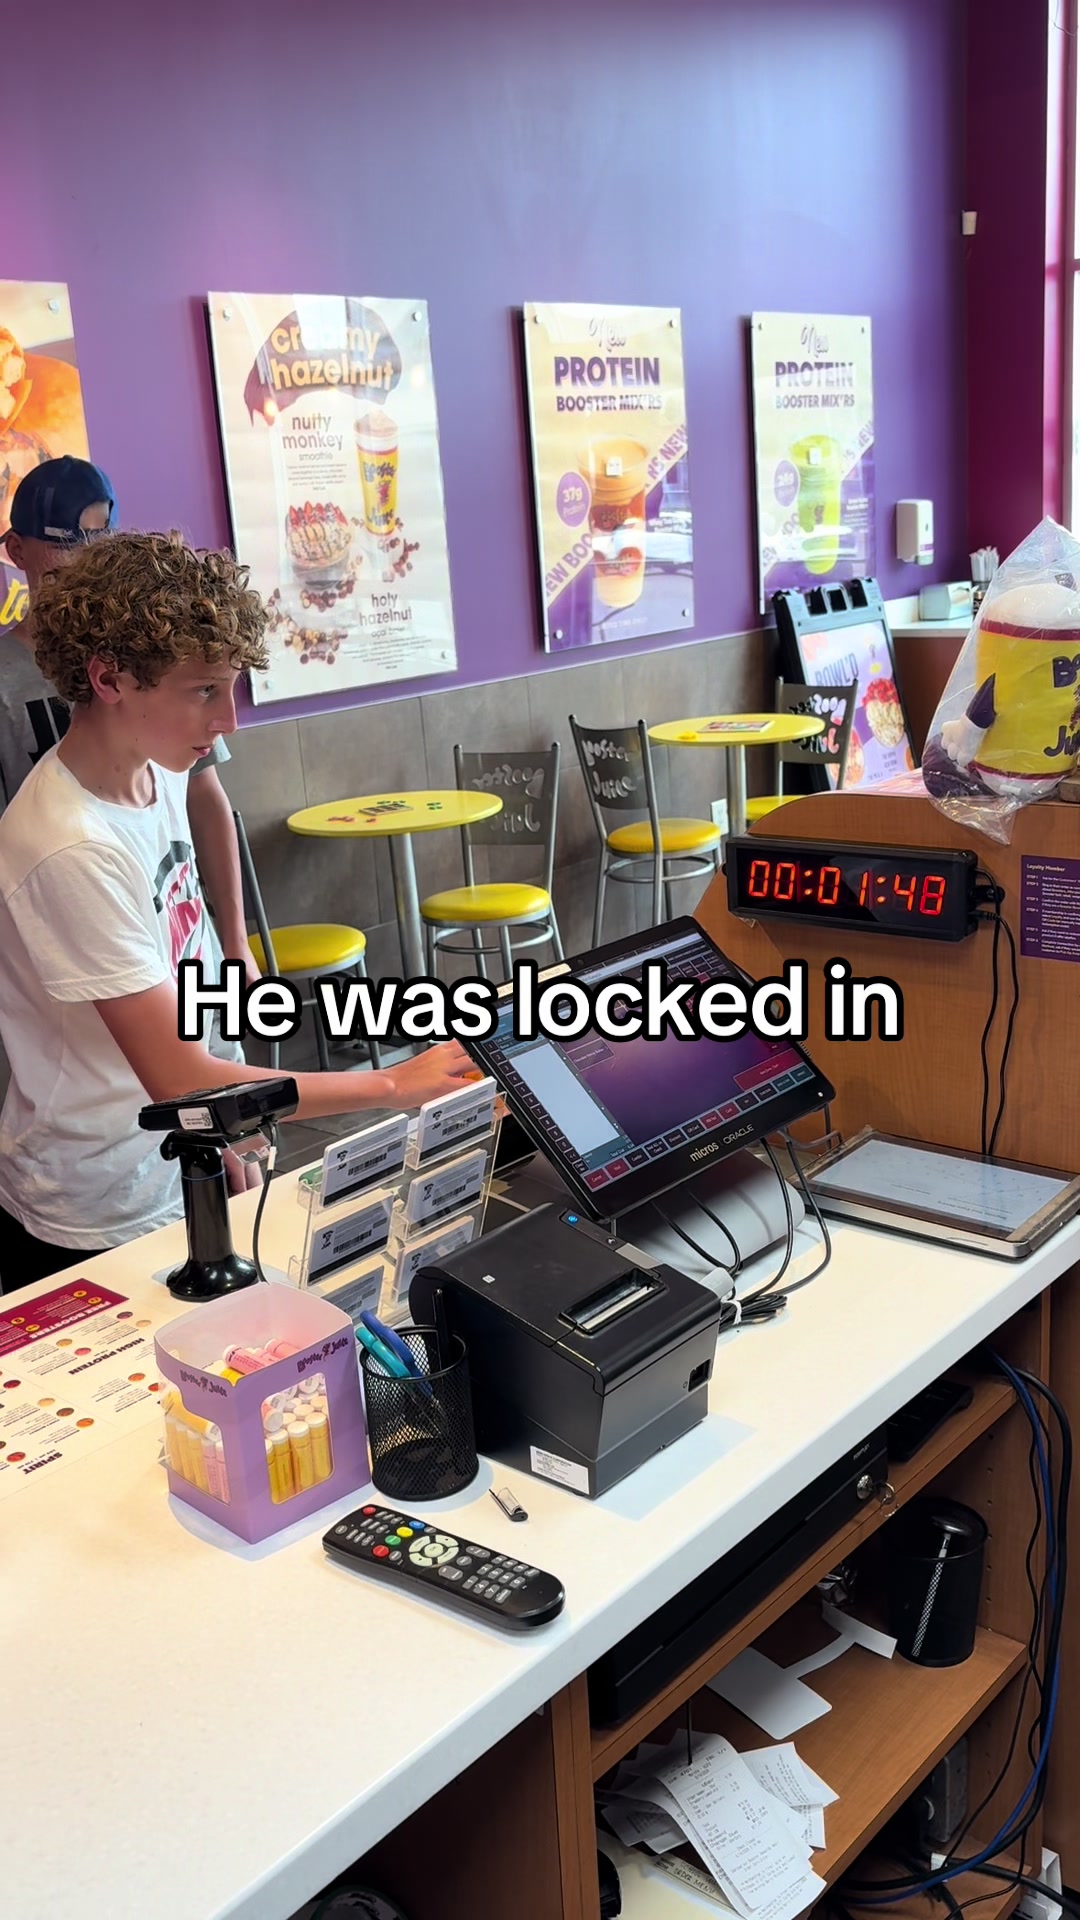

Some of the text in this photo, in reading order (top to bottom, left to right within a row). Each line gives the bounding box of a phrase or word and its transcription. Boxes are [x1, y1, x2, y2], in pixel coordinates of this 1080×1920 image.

[269, 353, 394, 391] hazelnut
[554, 355, 660, 387] PROTEIN
[775, 361, 854, 388] PROTEIN
[556, 395, 617, 412] BOOSTER
[776, 394, 820, 409] BOOSTER
[292, 413, 332, 432] nutty
[282, 432, 343, 451] monkey
[371, 592, 398, 609] holy
[359, 606, 412, 627] hazelnut
[747, 858, 947, 917] 00:01:48
[690, 1124, 754, 1162] micros ORACLE
[22, 1451, 63, 1475] SPIRIT
